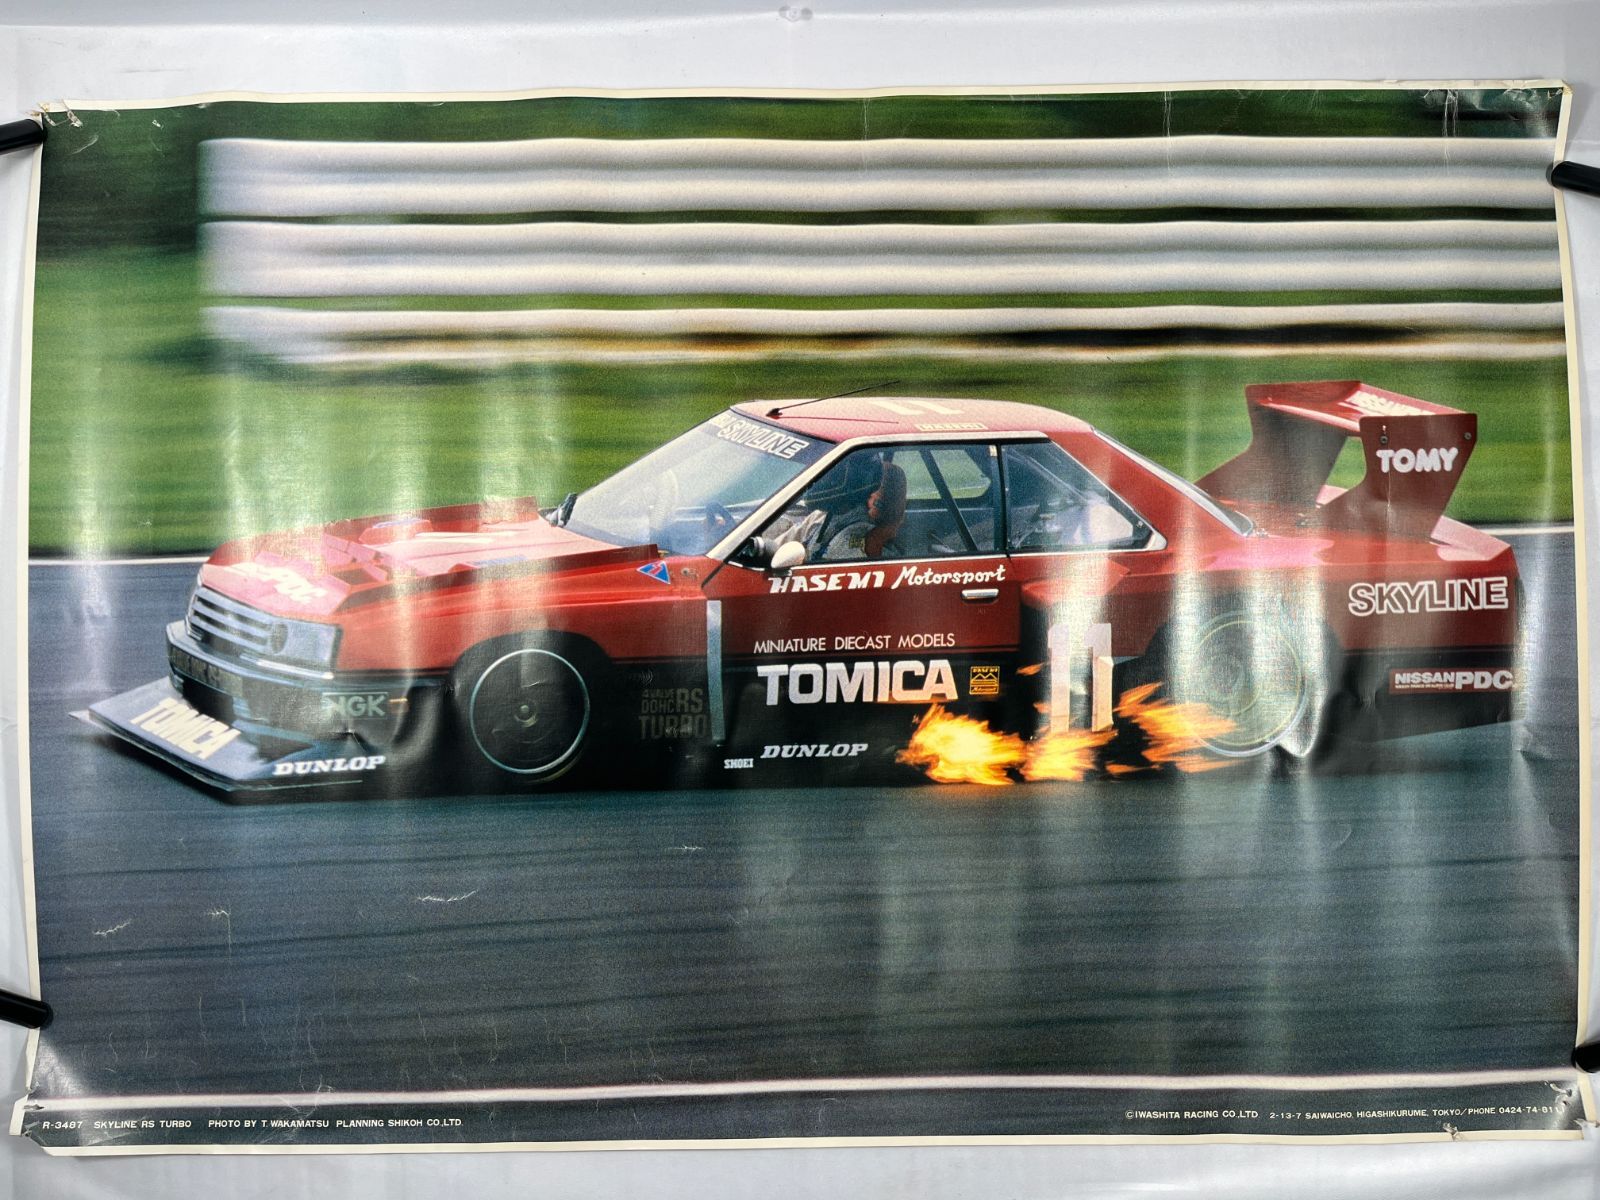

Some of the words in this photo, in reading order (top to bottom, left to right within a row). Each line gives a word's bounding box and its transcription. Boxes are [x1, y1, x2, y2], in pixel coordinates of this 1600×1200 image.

[1376, 447, 1459, 473] TOMY
[768, 570, 885, 594] HASEMI
[891, 564, 1006, 589] Motorsport
[1348, 576, 1509, 617] SKYLINE
[753, 638, 826, 655] MINIATURE
[834, 635, 891, 652] DIECAST
[897, 633, 956, 649] MODELS
[756, 659, 958, 706] TOMICA
[1047, 622, 1114, 735] 11
[1394, 671, 1455, 684] NISSAN
[1454, 670, 1514, 690] PDC
[324, 694, 386, 717] NGK
[676, 688, 704, 713] RS
[129, 696, 242, 760] TOMICA
[638, 714, 709, 740] TURBO
[760, 743, 869, 759] DUNLOP
[272, 755, 386, 777] DUNLOP
[42, 1120, 83, 1129] R-3487
[94, 1120, 137, 1129] SKYLINE
[141, 1120, 155, 1128] RS
[160, 1119, 192, 1128] TURBO
[208, 1119, 241, 1128] PHOTO
[244, 1119, 257, 1128] BY
[270, 1119, 329, 1128] WAKAMATSU
[336, 1119, 384, 1128] PLANNING
[388, 1118, 423, 1127] SHIKOH
[1184, 1110, 1219, 1119] RACING
[1269, 1111, 1302, 1120] 2-13-7
